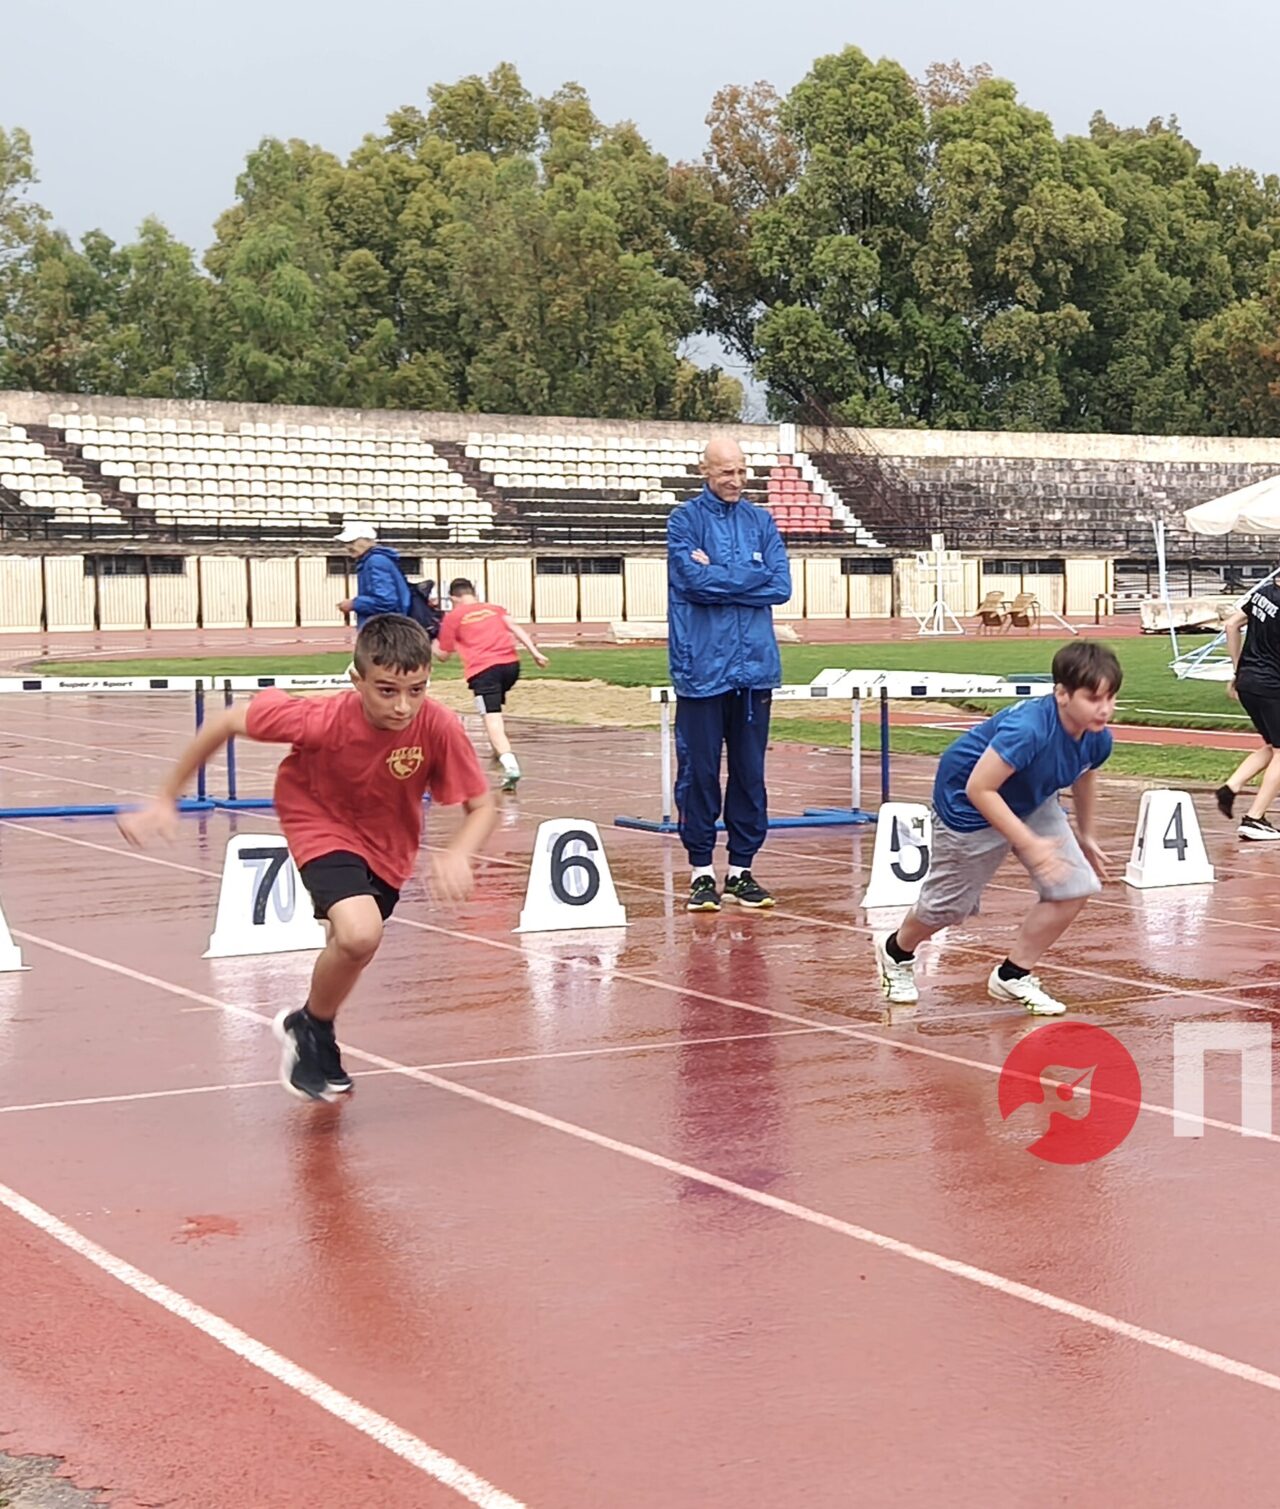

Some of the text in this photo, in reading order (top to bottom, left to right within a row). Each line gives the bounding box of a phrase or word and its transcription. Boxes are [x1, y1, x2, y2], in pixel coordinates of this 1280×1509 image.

[890, 815, 929, 882] 5
[1163, 802, 1188, 861] 4
[238, 847, 289, 925] 7
[551, 830, 600, 905] 6
